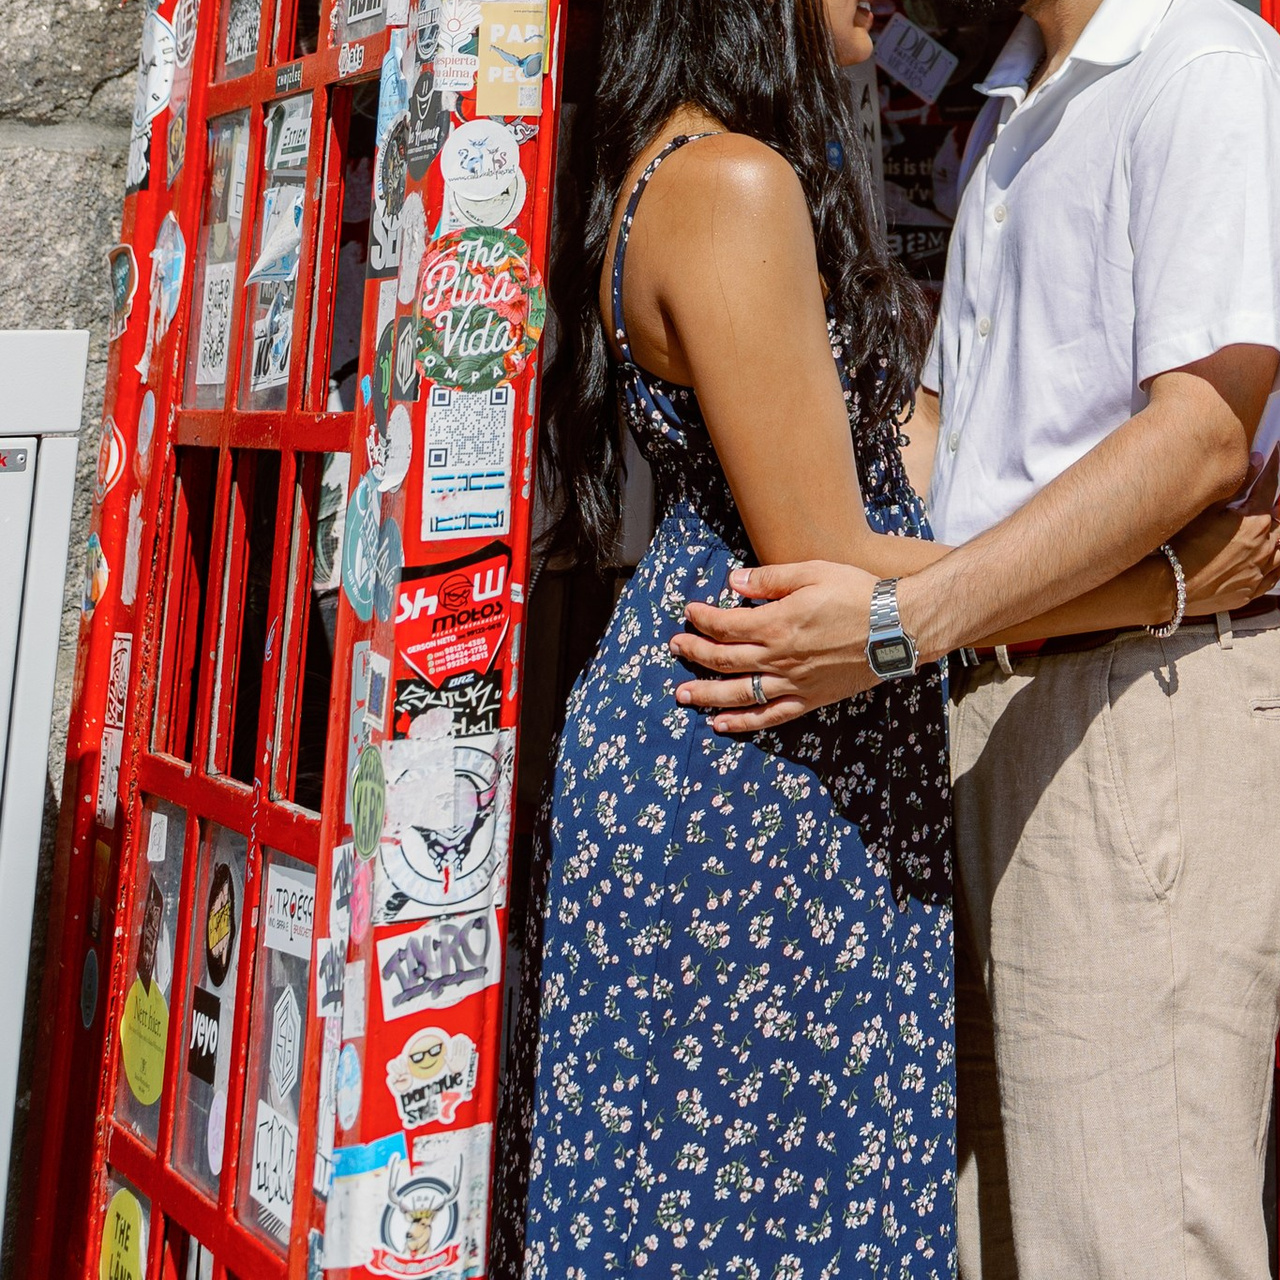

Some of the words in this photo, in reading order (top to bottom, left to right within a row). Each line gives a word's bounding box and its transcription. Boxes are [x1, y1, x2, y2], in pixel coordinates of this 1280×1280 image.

[456, 236, 511, 269] The
[422, 261, 517, 312] Pura
[435, 298, 519, 358] Vida
[431, 601, 504, 634] motos
[406, 638, 437, 655] GERSON
[436, 634, 457, 646] NETO
[189, 1009, 219, 1057] yeyo
[115, 1211, 132, 1252] THE
